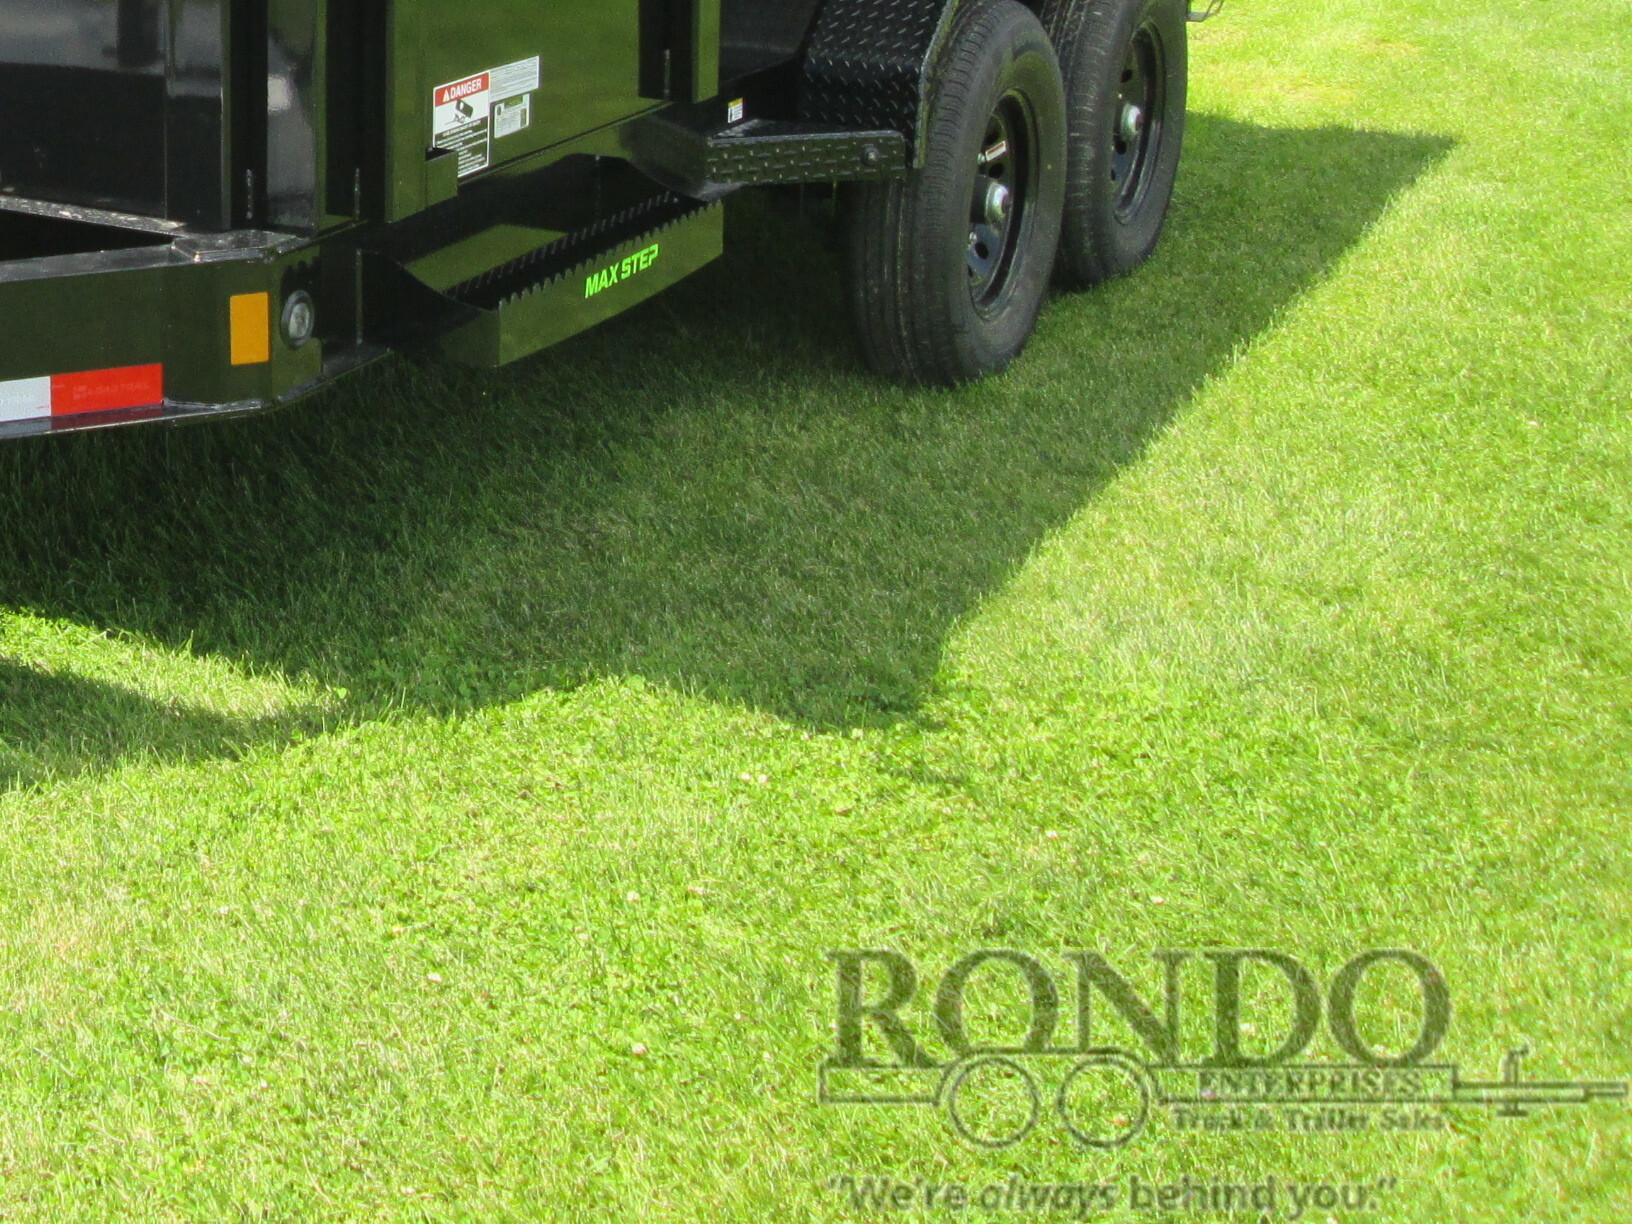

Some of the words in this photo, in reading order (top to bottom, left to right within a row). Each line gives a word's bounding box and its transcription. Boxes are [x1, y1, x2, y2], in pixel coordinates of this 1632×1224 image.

[450, 78, 483, 99] DANGER
[585, 263, 619, 298] MAX
[621, 244, 659, 279] STEP
